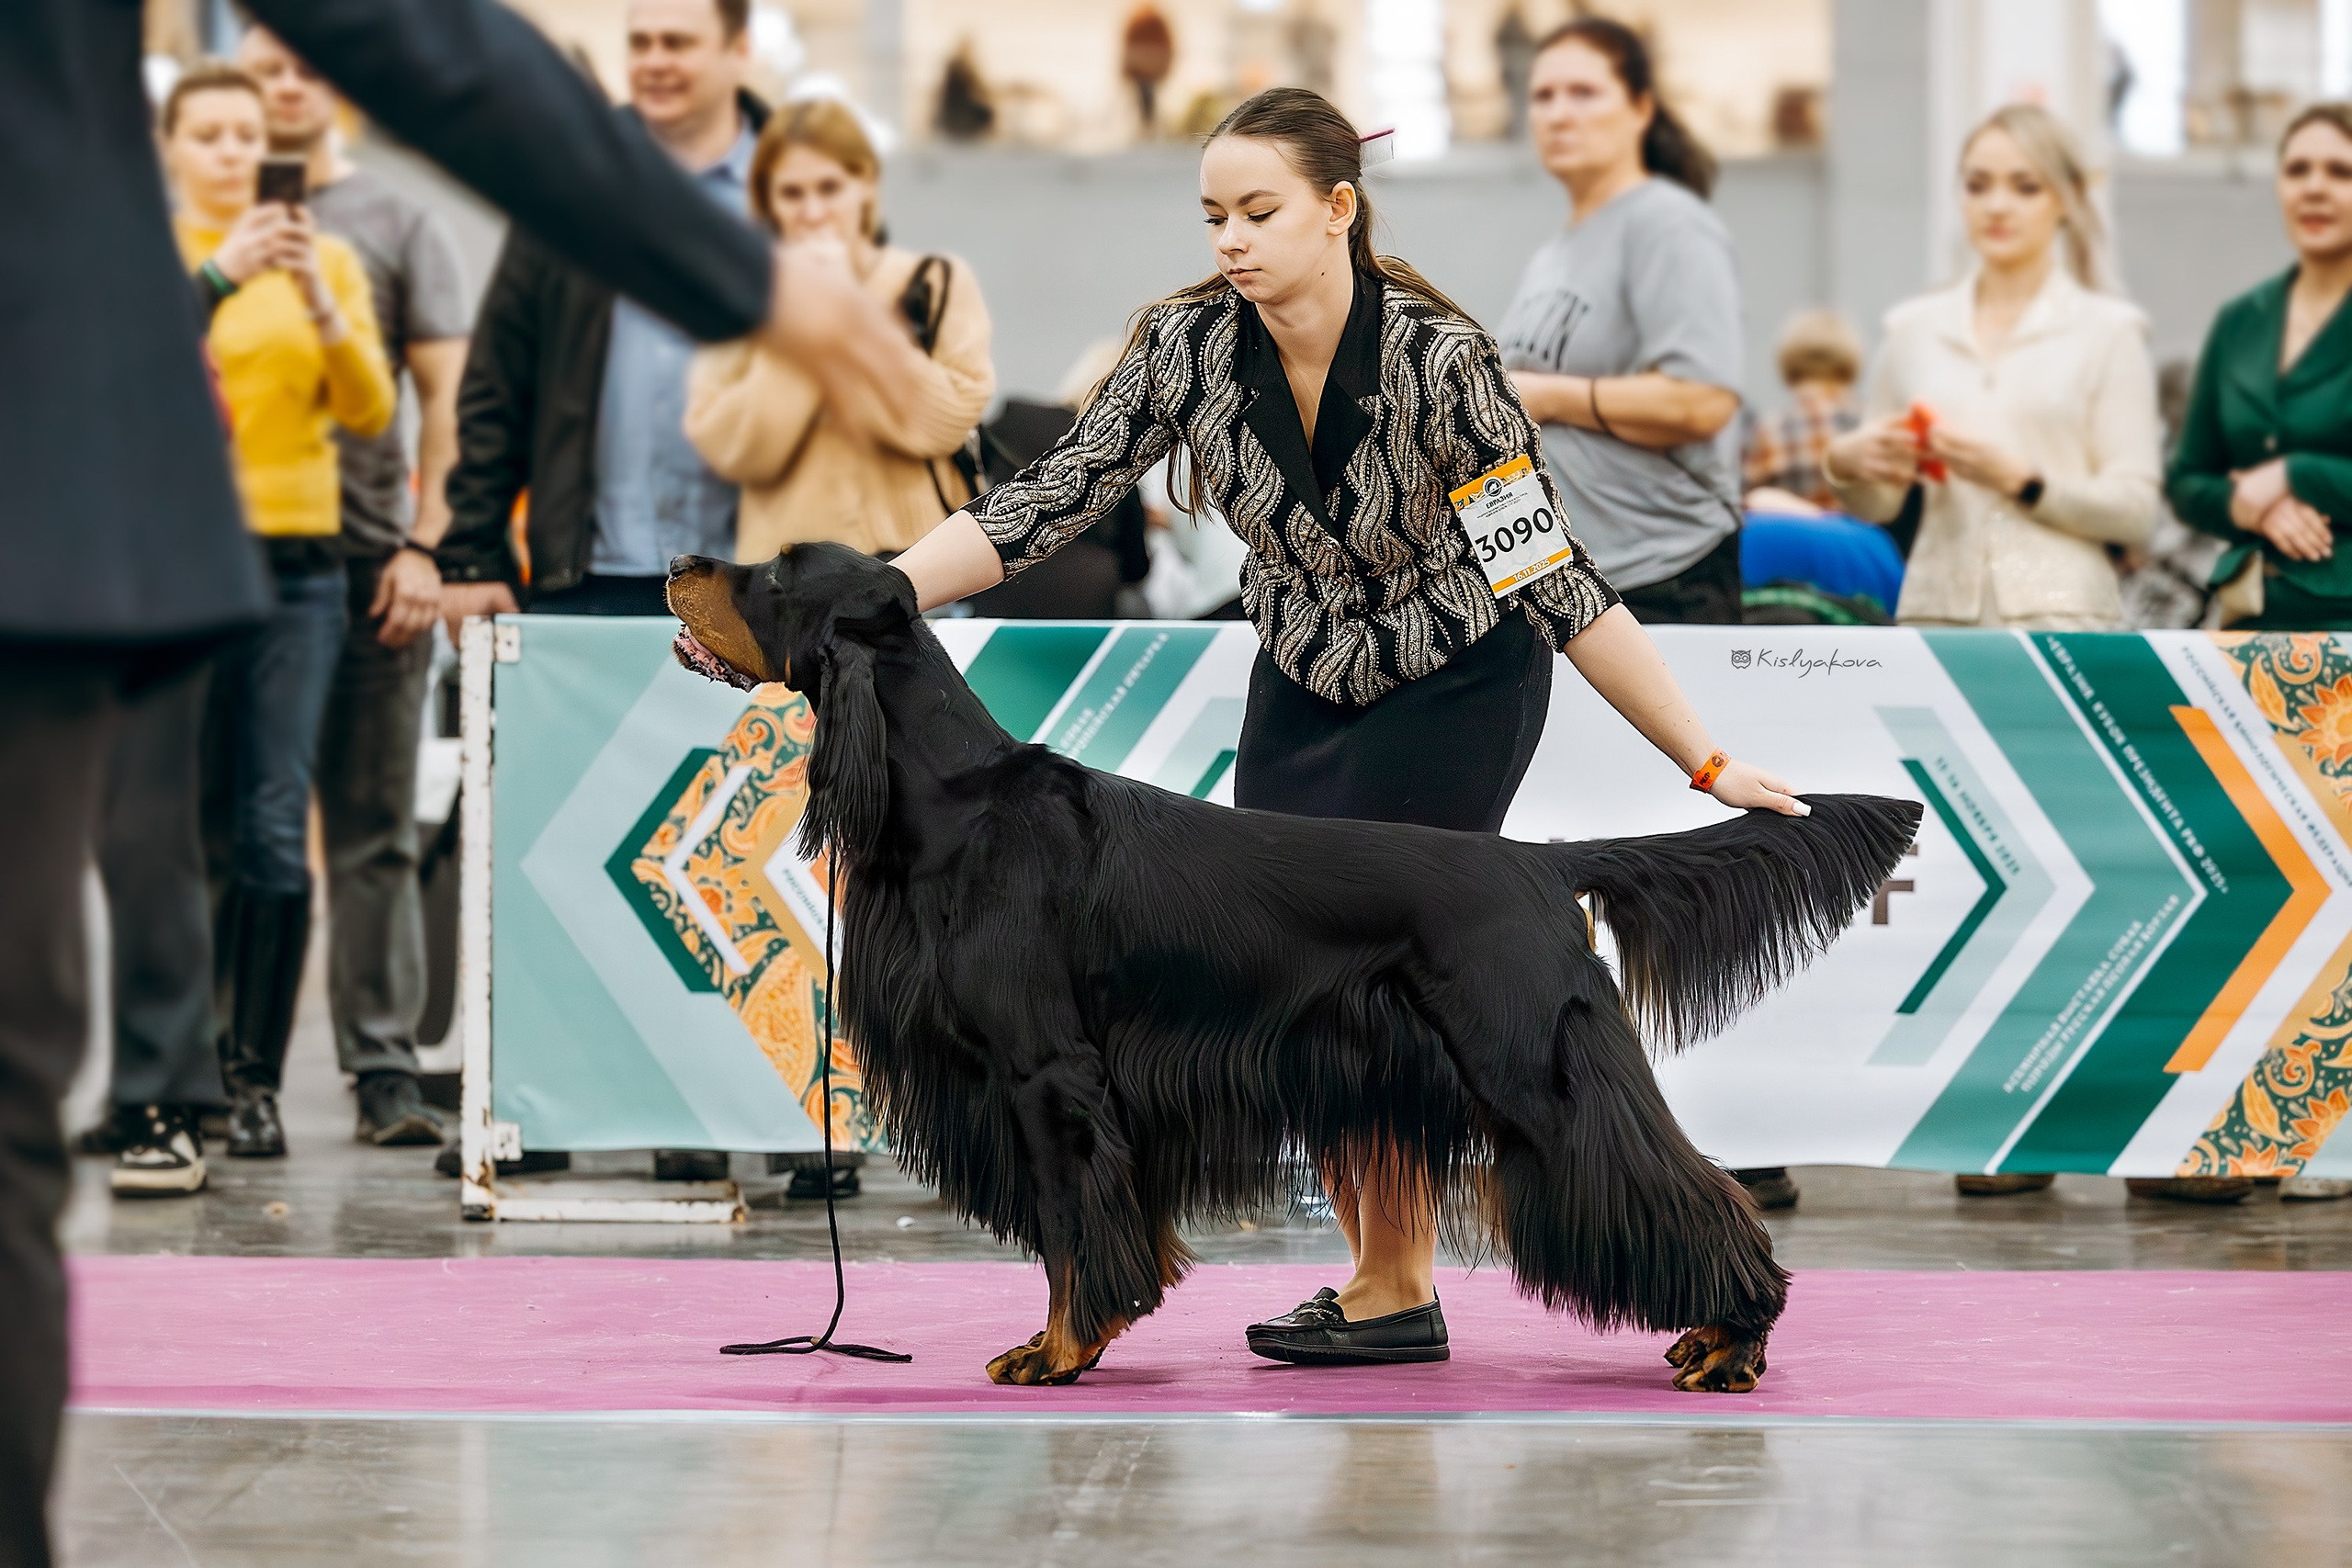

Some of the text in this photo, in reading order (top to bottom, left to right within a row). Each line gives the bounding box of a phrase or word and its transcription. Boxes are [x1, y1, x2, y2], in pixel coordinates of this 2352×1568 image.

[1485, 491, 1514, 509] ЕВРАЗИЯ
[1475, 507, 1554, 563] 3090
[1512, 558, 1551, 582] 16.11.2025
